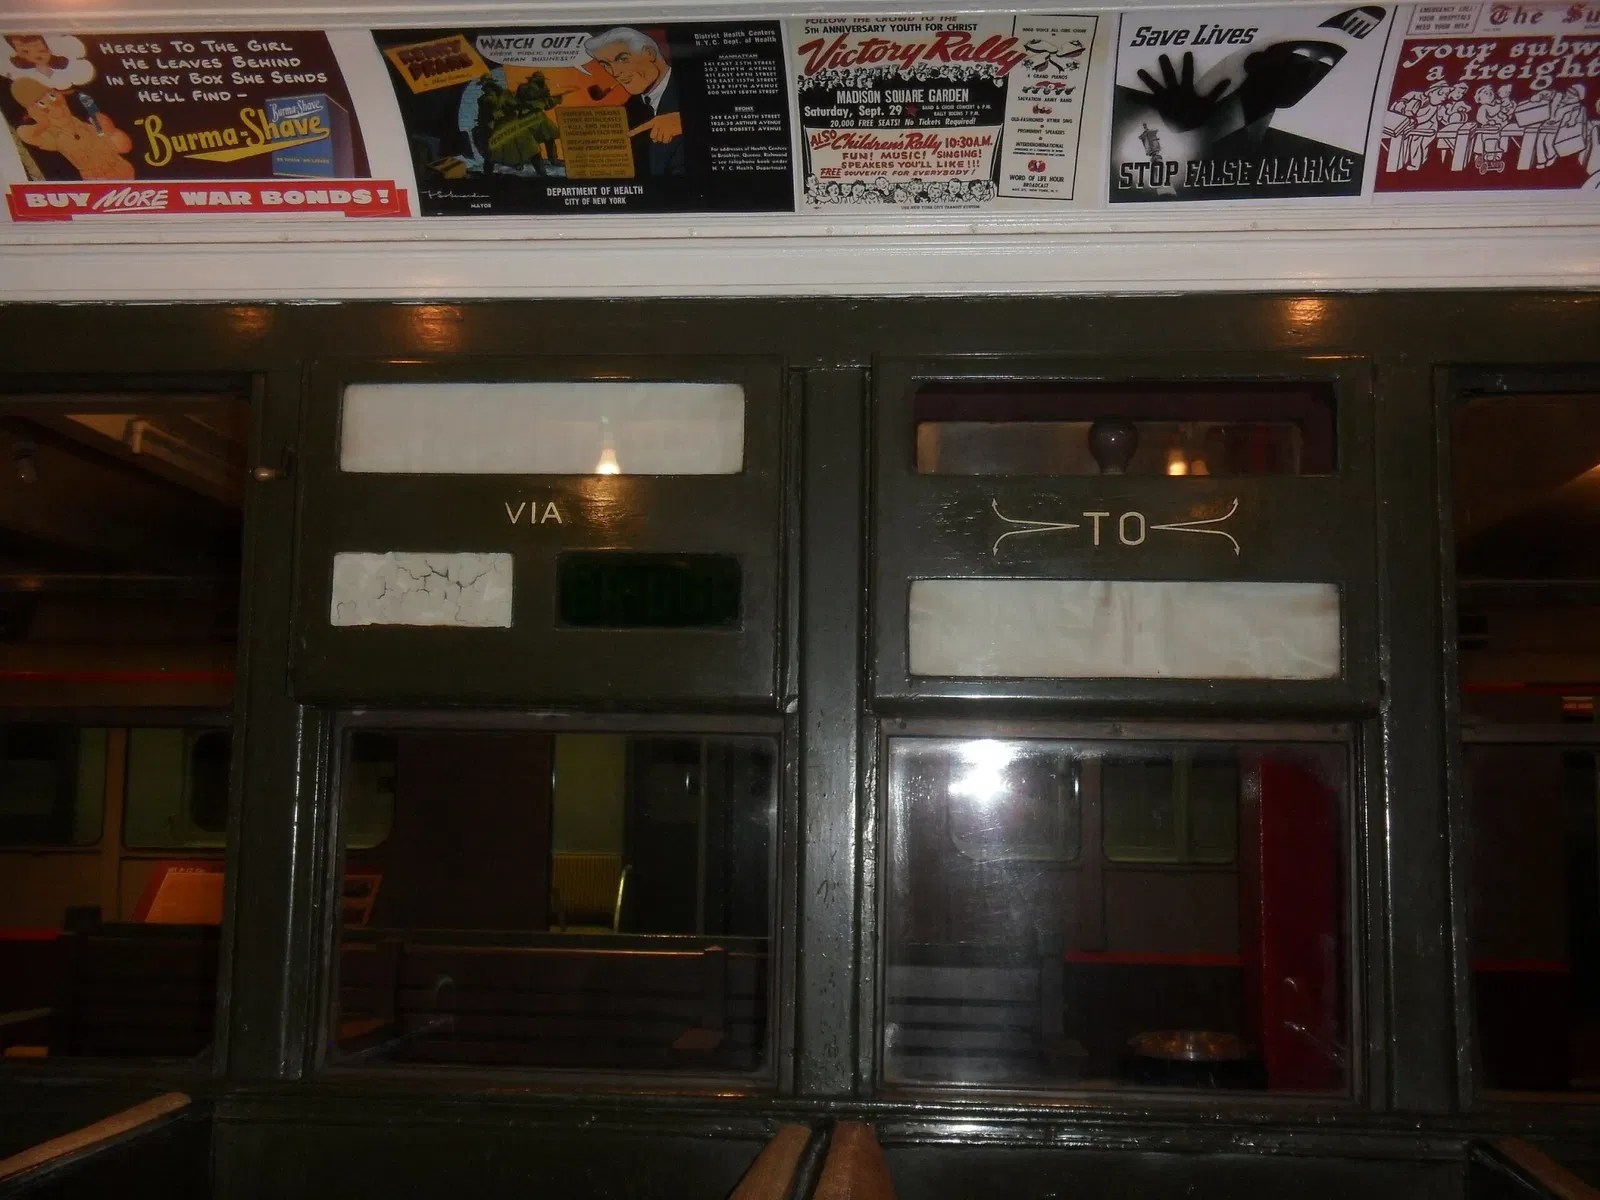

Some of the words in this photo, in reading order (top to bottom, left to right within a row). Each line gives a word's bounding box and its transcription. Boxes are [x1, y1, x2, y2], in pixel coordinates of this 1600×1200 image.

[805, 17, 847, 25] FOLLOW
[1489, 4, 1544, 25] The
[804, 26, 819, 34] 5TH
[822, 24, 886, 33] ANNIVERSARY
[890, 24, 922, 32] YOUTH
[925, 23, 943, 31] FOR
[947, 23, 978, 32] CHRIST
[1130, 26, 1193, 47] Save
[1191, 24, 1259, 46] Lives
[100, 43, 162, 54] HERE'S
[171, 41, 194, 53] TO
[201, 40, 238, 52] THE
[247, 40, 293, 52] GIRL
[481, 37, 534, 50] WATCH
[797, 32, 931, 76] Victory
[922, 31, 1028, 76] Rally
[1403, 42, 1497, 68] your
[122, 58, 149, 70] HE
[157, 58, 223, 69] LEAVES
[232, 56, 301, 68] BEHIND
[106, 75, 124, 86] IN
[130, 74, 180, 85] EVERY
[190, 73, 224, 84] BOX
[232, 73, 264, 84] SHE
[272, 72, 328, 84] SENDS
[1426, 65, 1445, 81] a
[1459, 54, 1600, 91] freight
[138, 91, 185, 103] HE'LL
[192, 91, 231, 101] FIND
[836, 90, 881, 104] MADISON
[885, 89, 924, 103] SQUARE
[928, 88, 969, 103] GARDEN
[270, 100, 324, 122] Burma-Shave
[804, 105, 853, 118] Saturday,
[859, 105, 885, 117] Sept.
[889, 105, 903, 116] 29
[830, 119, 854, 128] 20,000
[858, 119, 875, 127] FREE
[878, 118, 901, 127] SEATS!
[904, 118, 914, 126] No
[919, 117, 941, 126] Tickets
[945, 117, 976, 127] Required!
[134, 107, 331, 167] Burma-Shave
[810, 130, 838, 147] ALSO
[899, 132, 943, 155] Rally
[842, 152, 874, 161] FUN!
[880, 151, 927, 160] MUSIC!
[936, 150, 983, 159] SINGING!
[841, 161, 893, 169] SPEAKERS
[899, 160, 932, 168] YOU'LL
[820, 168, 842, 177] FREE
[1118, 160, 1180, 190] STOP
[1183, 159, 1253, 188] FALSE
[1257, 154, 1355, 186] ALARMS
[25, 192, 90, 208] BUY
[92, 187, 169, 208] MORE
[179, 190, 252, 205] WAR
[547, 187, 597, 196] DEPARTMENT
[601, 187, 611, 195] OF
[614, 186, 644, 195] HEALTH
[592, 197, 607, 205] NEW
[609, 197, 627, 205] YORK
[505, 502, 563, 525] VIA
[1082, 511, 1146, 546] TO
